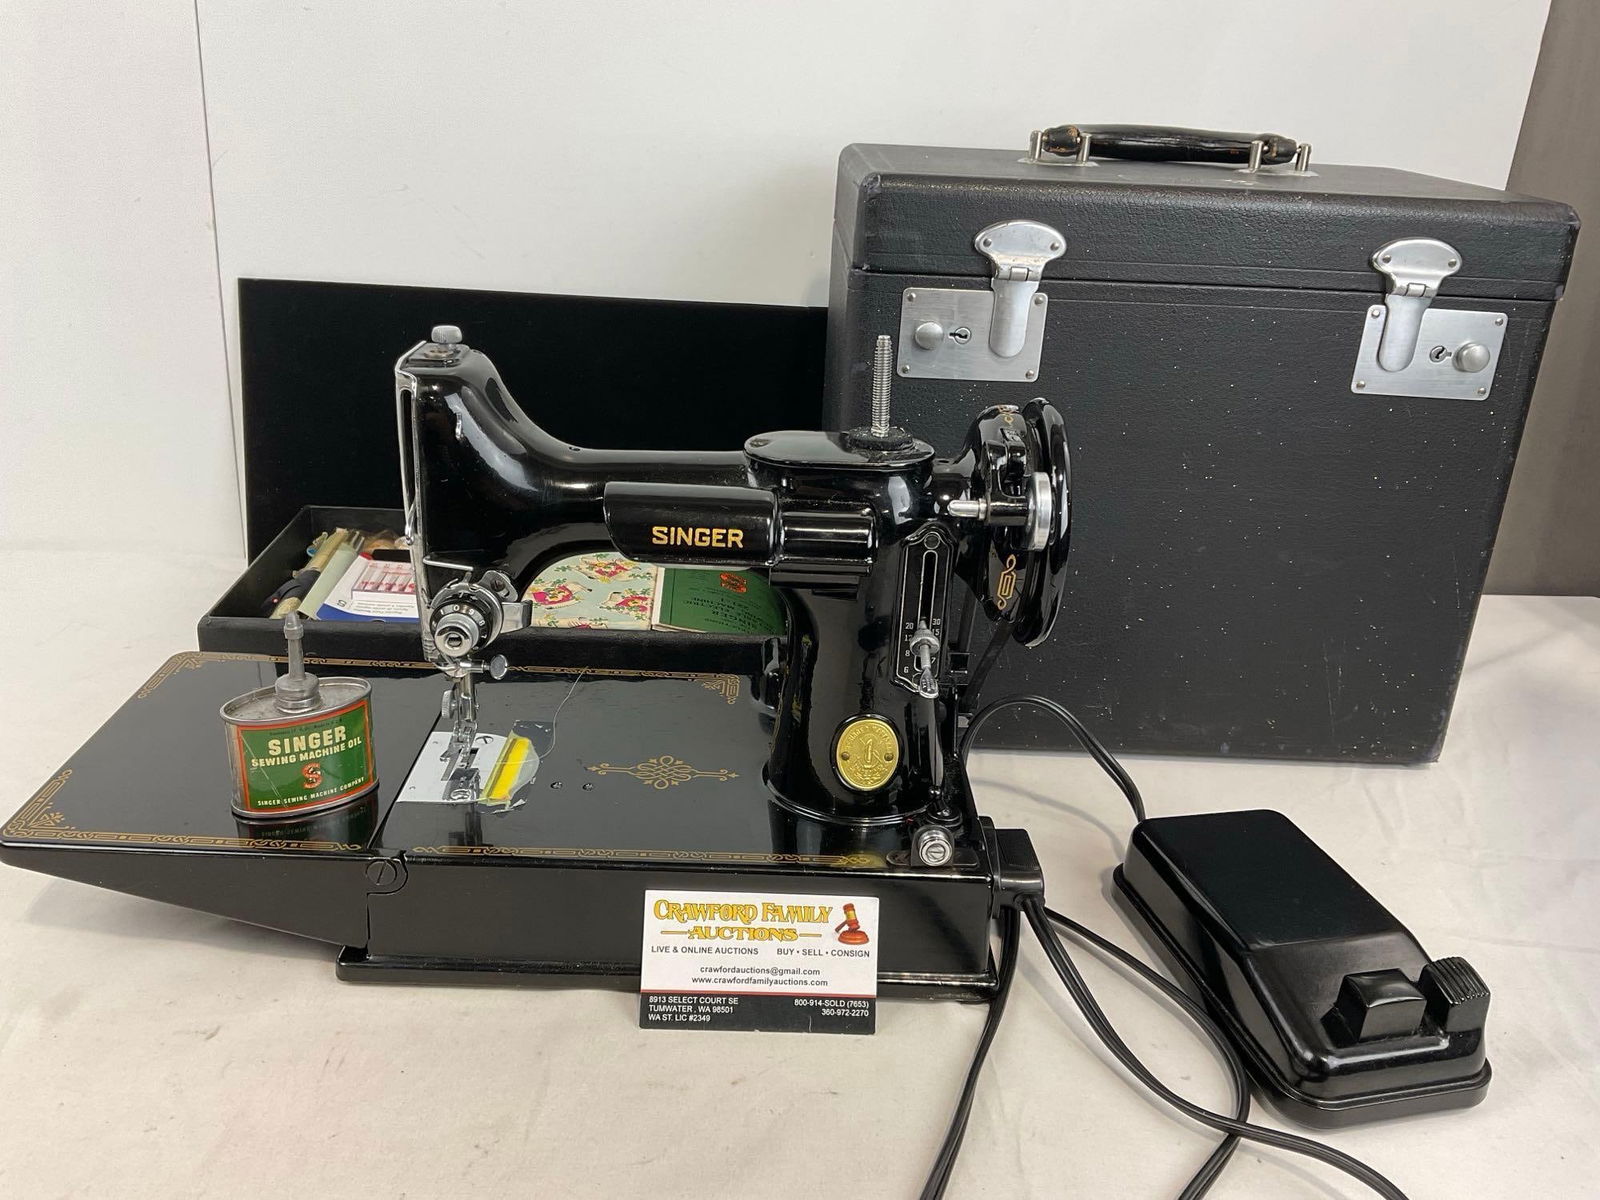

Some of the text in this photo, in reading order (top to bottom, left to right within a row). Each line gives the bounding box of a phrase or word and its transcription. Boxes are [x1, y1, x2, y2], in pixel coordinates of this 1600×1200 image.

[651, 526, 744, 548] SINGER
[905, 618, 941, 630] 20 30
[904, 649, 911, 657] 8
[903, 666, 910, 674] 6
[268, 725, 347, 756] SINGER
[251, 736, 362, 767] SEWING MACHINE OIL
[283, 795, 308, 804] SEWING
[310, 787, 338, 799] MACHINE
[340, 776, 365, 791] COMPANY
[653, 899, 834, 925] CRAWFORD FAMILY
[687, 925, 799, 942] AUCTIONS
[651, 946, 759, 955] LIVE & ONLINE AUCTIONS
[776, 948, 870, 958] BUY SELL CONSIGN
[699, 965, 821, 977] crawfordauctions@gmail.com
[691, 976, 829, 987] www.crawfordfamilyauctions.com
[667, 995, 698, 1004] SELECT
[699, 996, 727, 1005] COURT
[728, 997, 739, 1005] SE
[794, 998, 846, 1007] 800-914-SOLD
[697, 1005, 711, 1013] WA
[648, 1013, 661, 1021] WA
